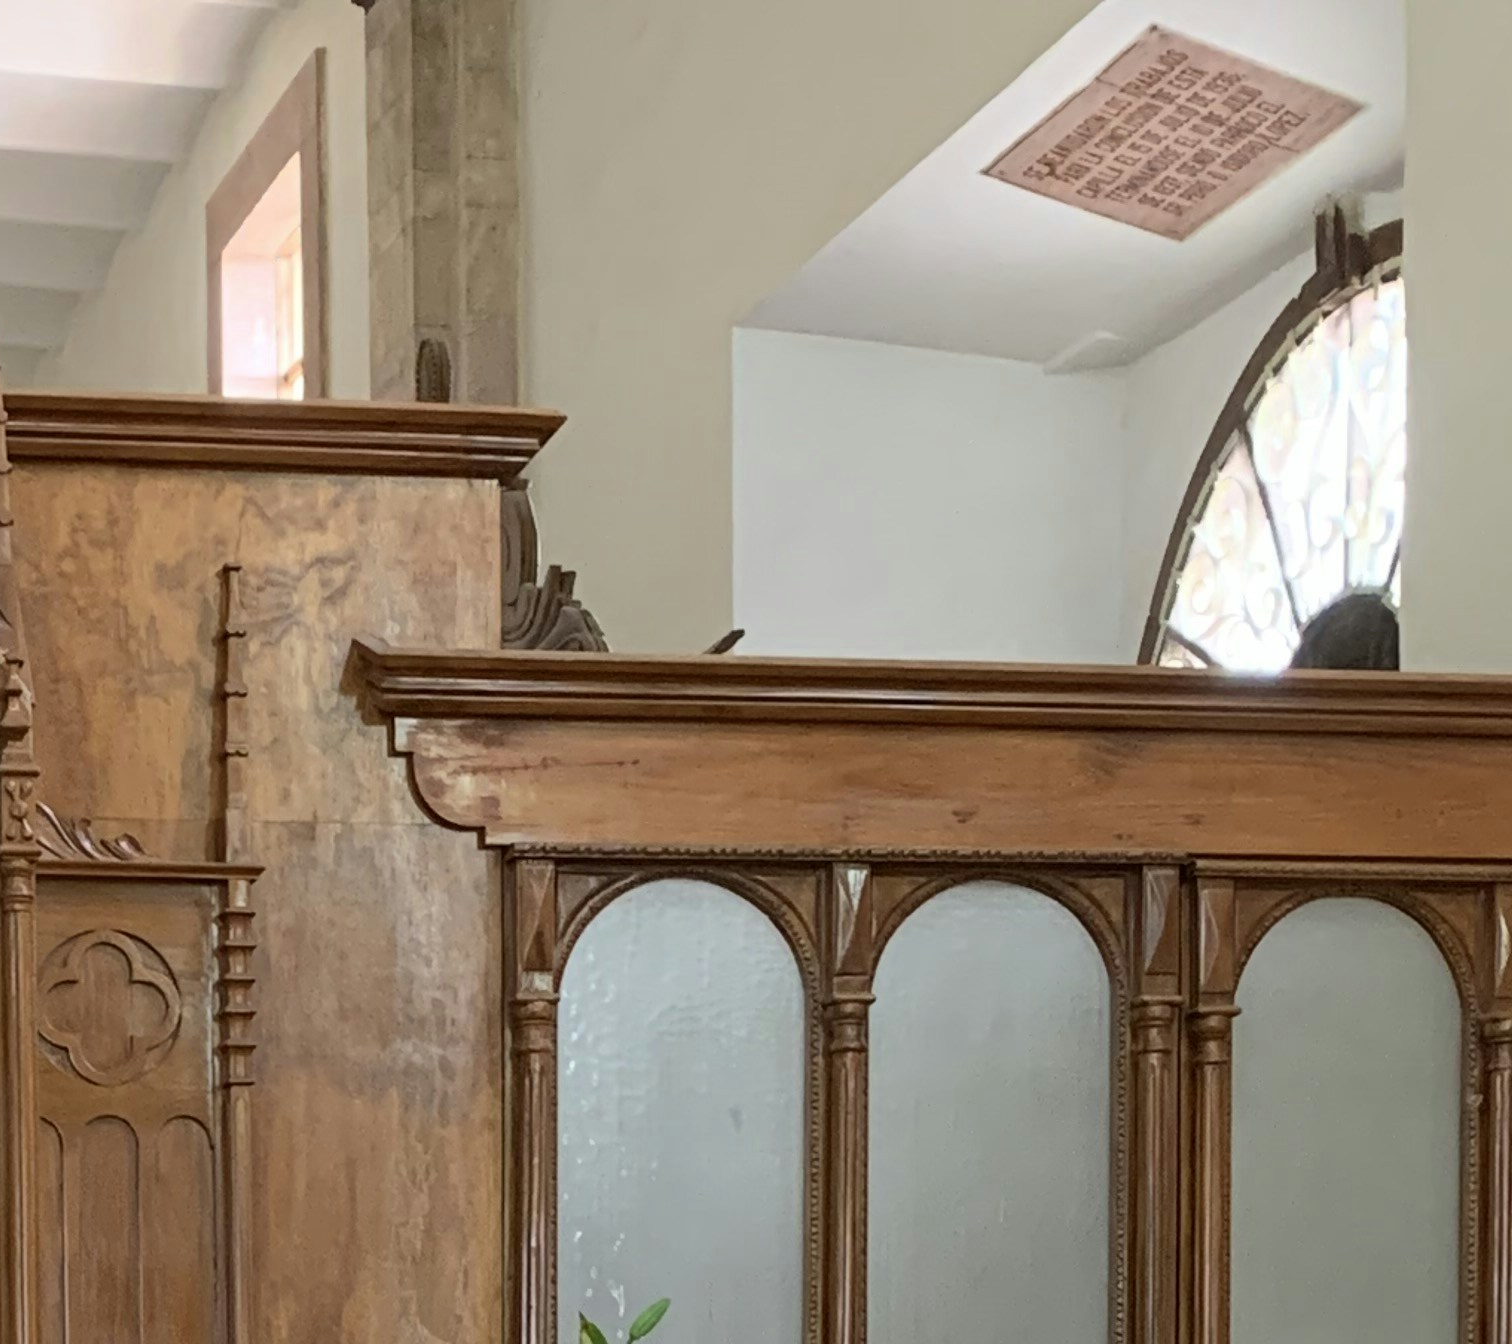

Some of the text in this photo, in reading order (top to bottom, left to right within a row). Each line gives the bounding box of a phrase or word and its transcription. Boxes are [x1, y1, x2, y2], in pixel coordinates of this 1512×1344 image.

[1117, 47, 1191, 99] TRABAJOS
[1165, 64, 1210, 91] ESTA
[1149, 87, 1182, 105] DE
[1073, 164, 1127, 199] CAPILLA
[1111, 151, 1142, 166] EL
[1137, 128, 1169, 145] DE
[1184, 91, 1216, 107] DE
[1171, 132, 1202, 148] EL
[1198, 110, 1231, 127] DE
[1133, 192, 1166, 208] DE
[1253, 97, 1287, 114] EL
